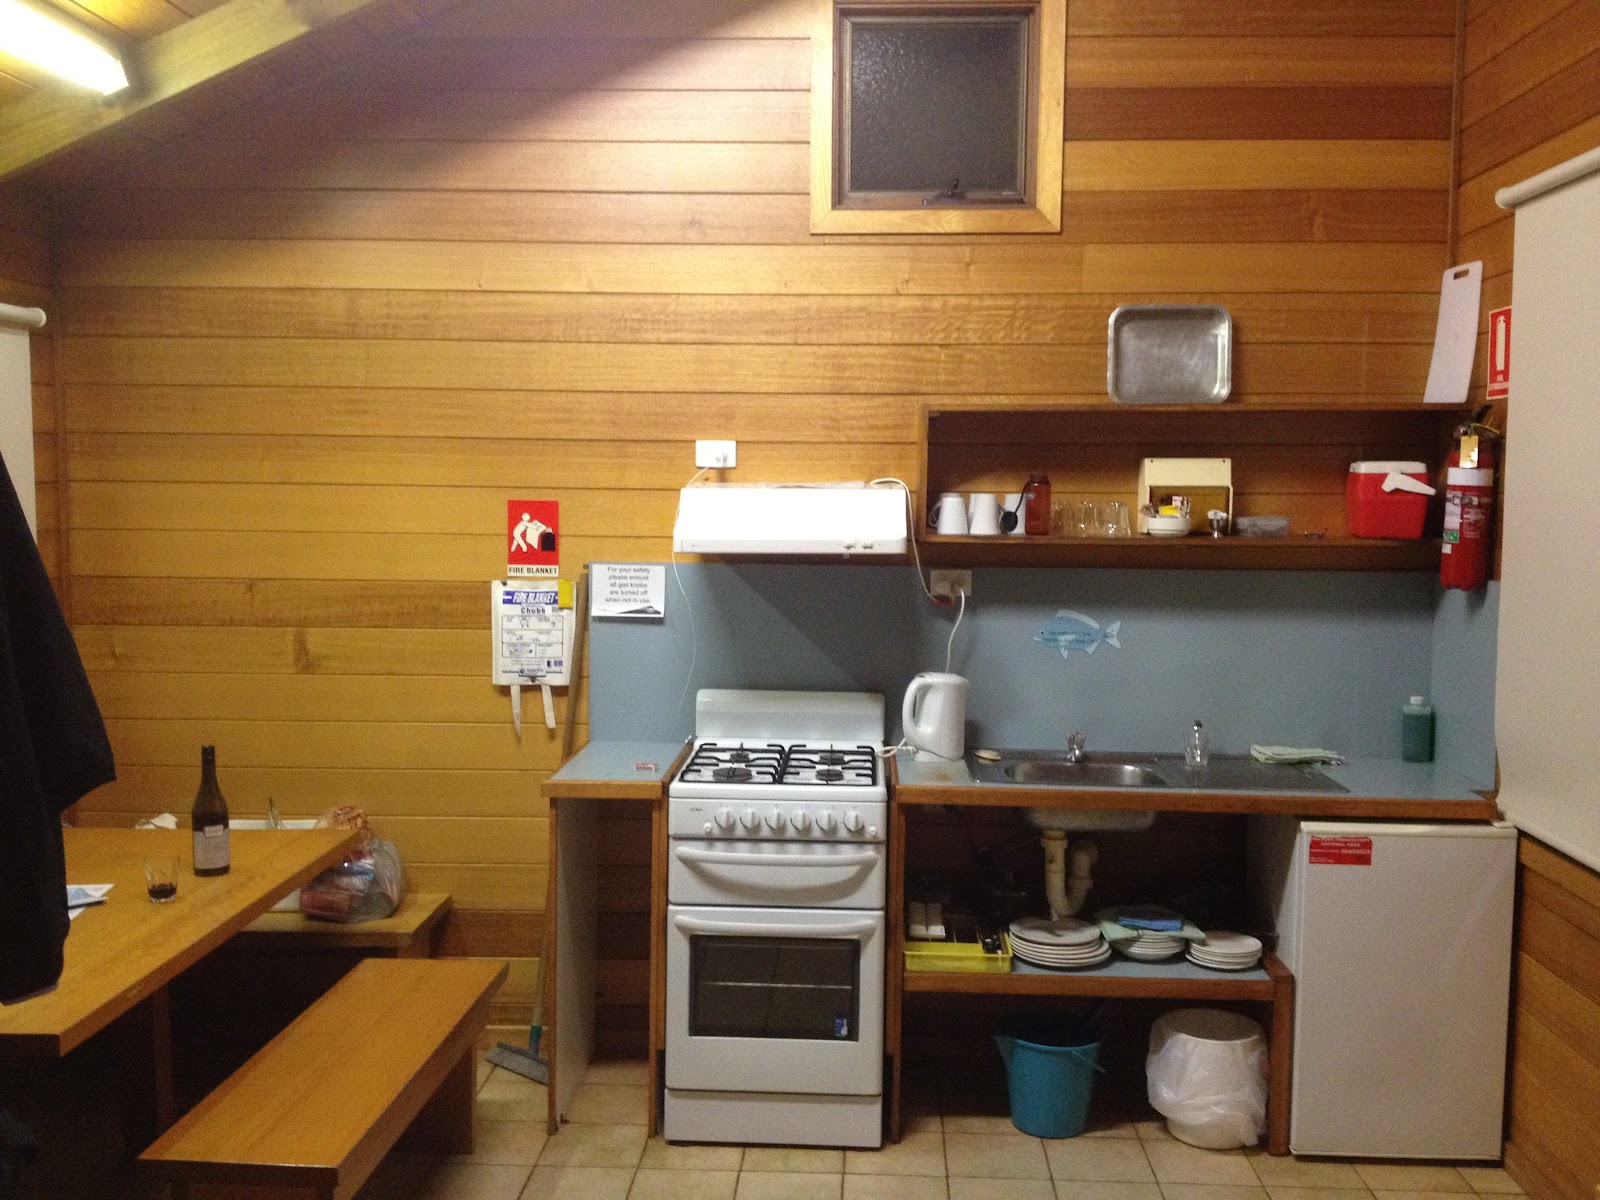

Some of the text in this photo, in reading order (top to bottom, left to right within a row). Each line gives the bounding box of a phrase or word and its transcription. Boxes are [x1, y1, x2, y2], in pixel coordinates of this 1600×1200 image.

[633, 566, 650, 574] safety
[512, 591, 556, 604] FIRE BLANKET
